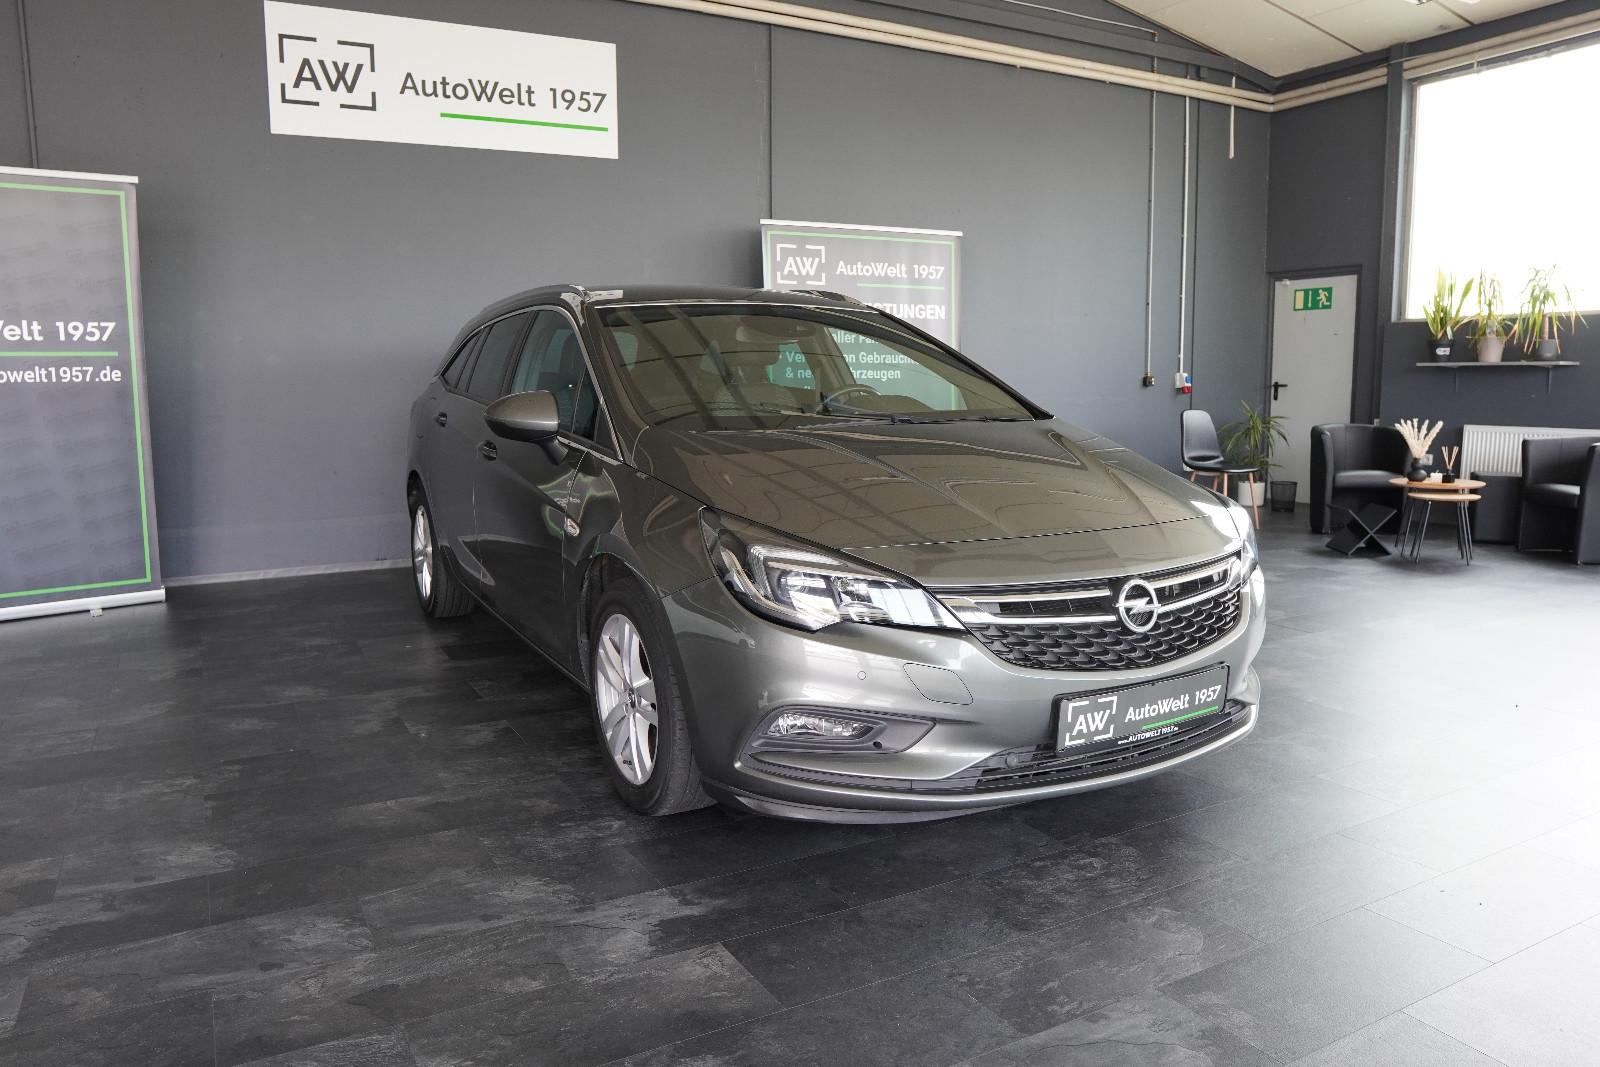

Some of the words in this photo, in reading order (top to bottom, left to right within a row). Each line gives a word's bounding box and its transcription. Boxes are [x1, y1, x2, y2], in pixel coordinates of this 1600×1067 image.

[292, 58, 364, 94] AW
[399, 72, 537, 108] AutoWelt
[549, 87, 608, 114] 1957
[783, 256, 820, 276] AW
[835, 260, 908, 278] AutoWelt
[913, 264, 945, 280] 1957
[0, 319, 44, 341] elt
[55, 321, 117, 342] 1957
[785, 367, 794, 378] &
[797, 369, 814, 378] ne
[1124, 693, 1190, 723] AutoWelt
[1194, 684, 1222, 705] 1957
[1071, 709, 1111, 736] AW
